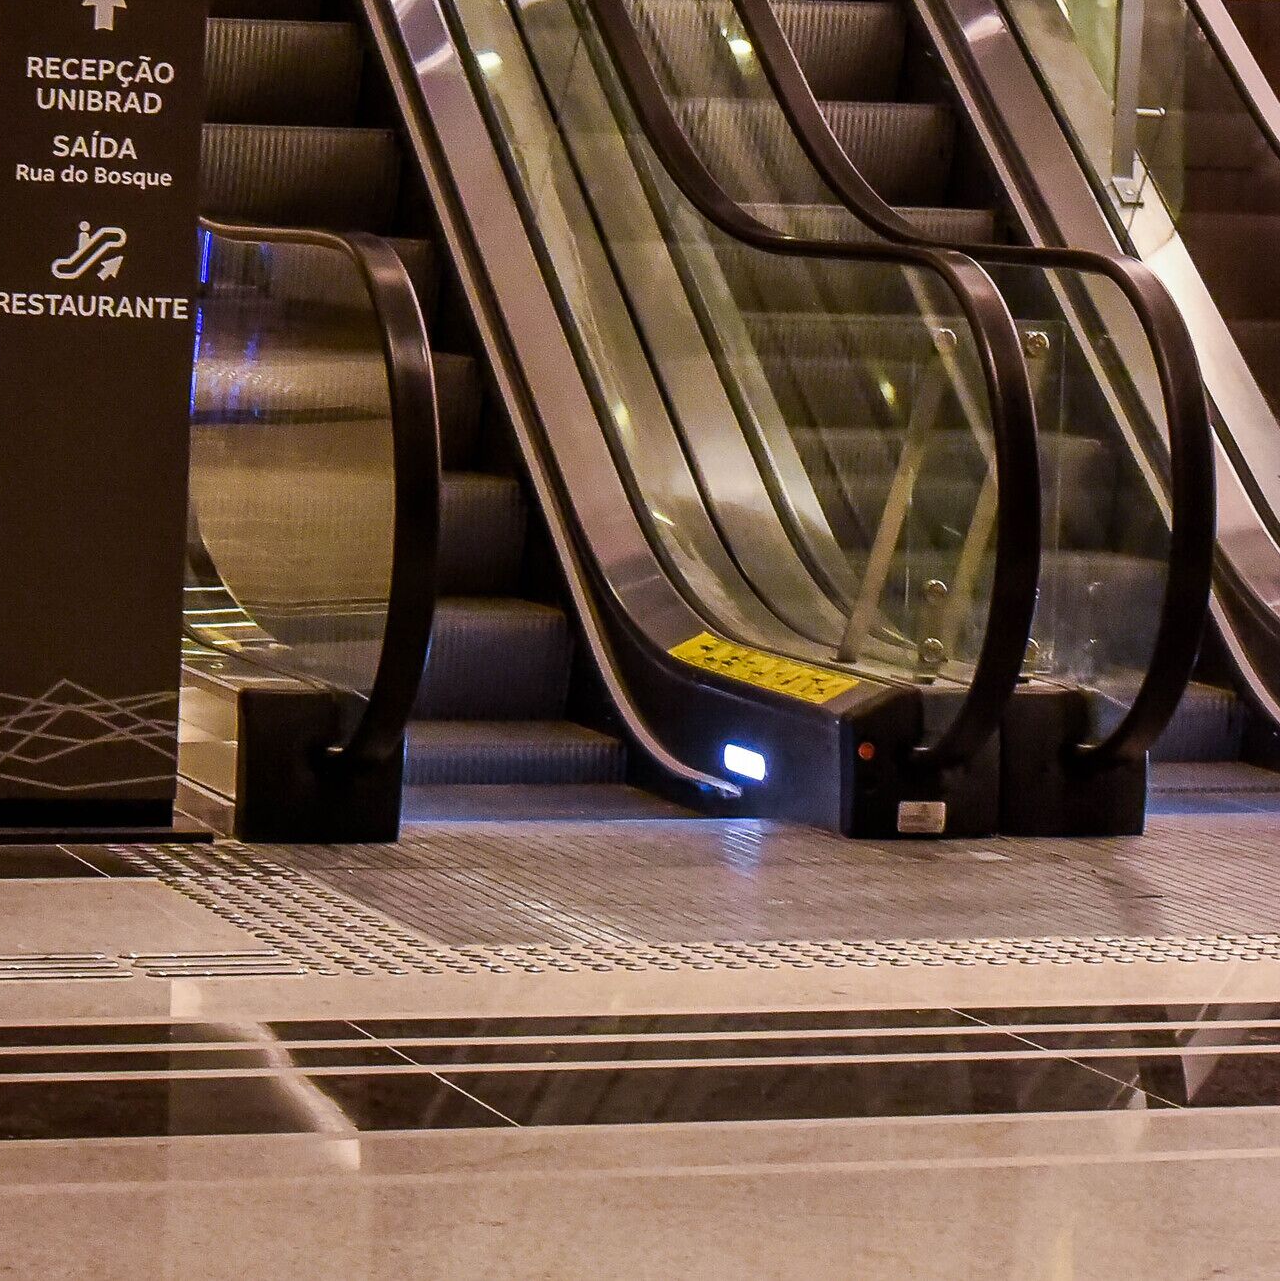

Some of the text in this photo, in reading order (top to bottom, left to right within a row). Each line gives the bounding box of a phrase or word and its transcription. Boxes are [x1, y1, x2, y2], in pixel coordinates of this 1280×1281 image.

[26, 55, 175, 88] RECEPÇÃO
[36, 87, 163, 114] UNIBRAD
[52, 130, 138, 160] SAÍDA
[15, 163, 173, 190] Rua do Bosque
